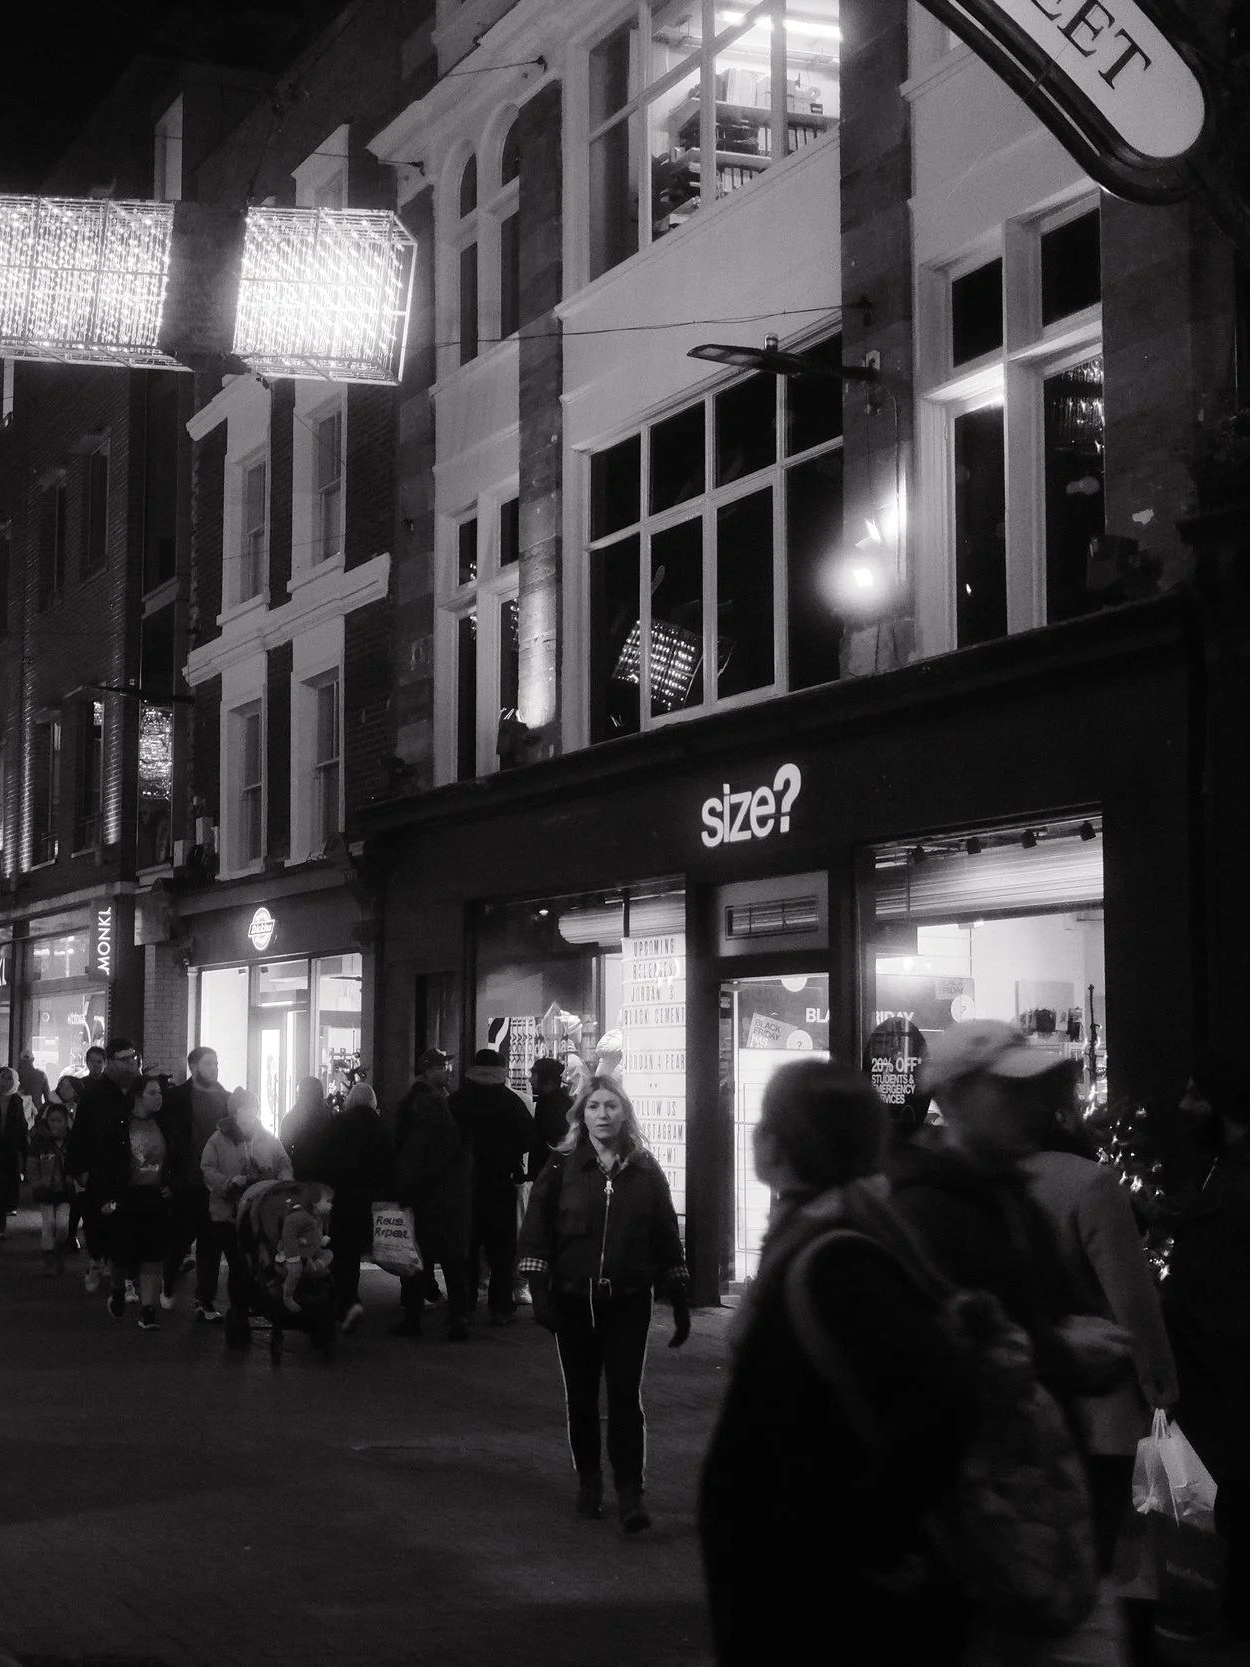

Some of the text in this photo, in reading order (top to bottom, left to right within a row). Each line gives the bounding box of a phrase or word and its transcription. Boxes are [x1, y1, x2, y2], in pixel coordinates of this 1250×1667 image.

[701, 762, 802, 848] size?
[97, 906, 112, 976] MONKI
[633, 938, 674, 957] UPCOMING
[631, 986, 661, 1002] JORDAN
[871, 1057, 894, 1073] 20%
[871, 1074, 915, 1085] STUDENTS &
